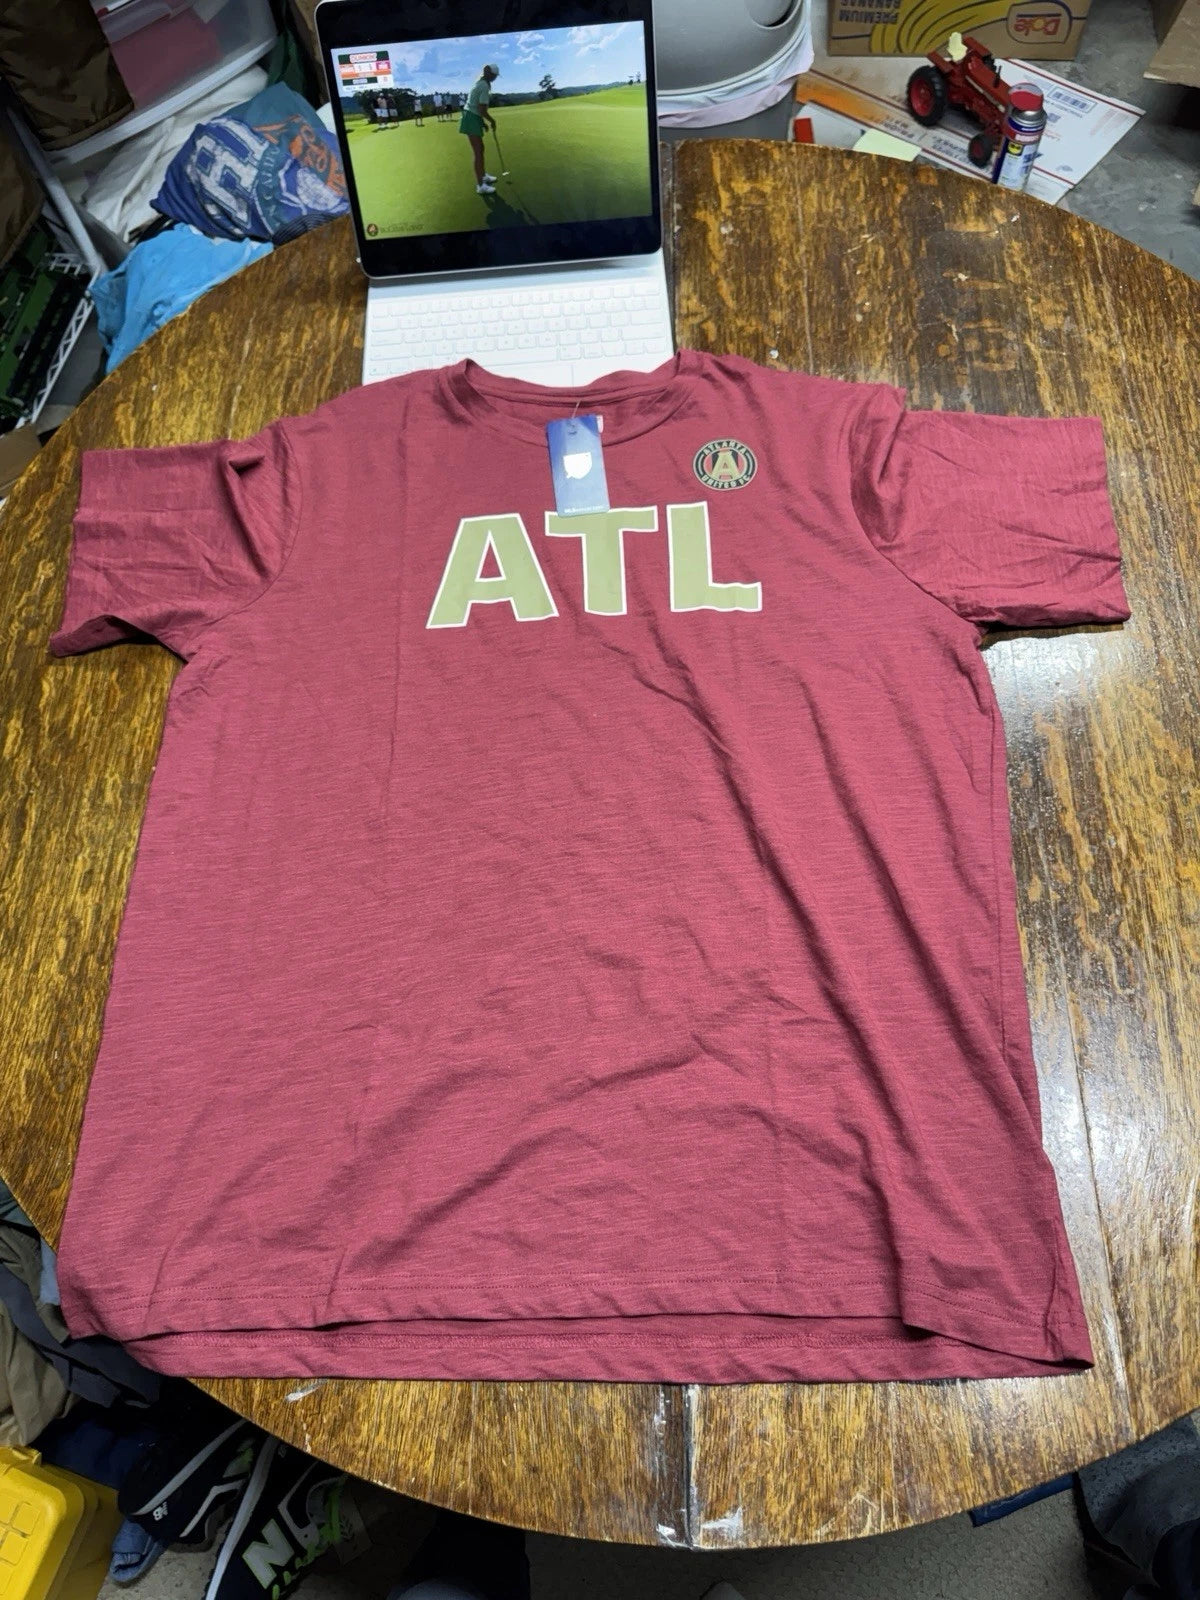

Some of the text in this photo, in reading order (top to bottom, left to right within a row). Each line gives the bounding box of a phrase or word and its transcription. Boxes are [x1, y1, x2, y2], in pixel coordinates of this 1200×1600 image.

[838, 11, 898, 25] PREMIUM
[1014, 17, 1062, 37] Dole
[702, 440, 747, 456] ATLANTA
[701, 474, 751, 489] UNITED FC
[425, 501, 762, 629] ATL
